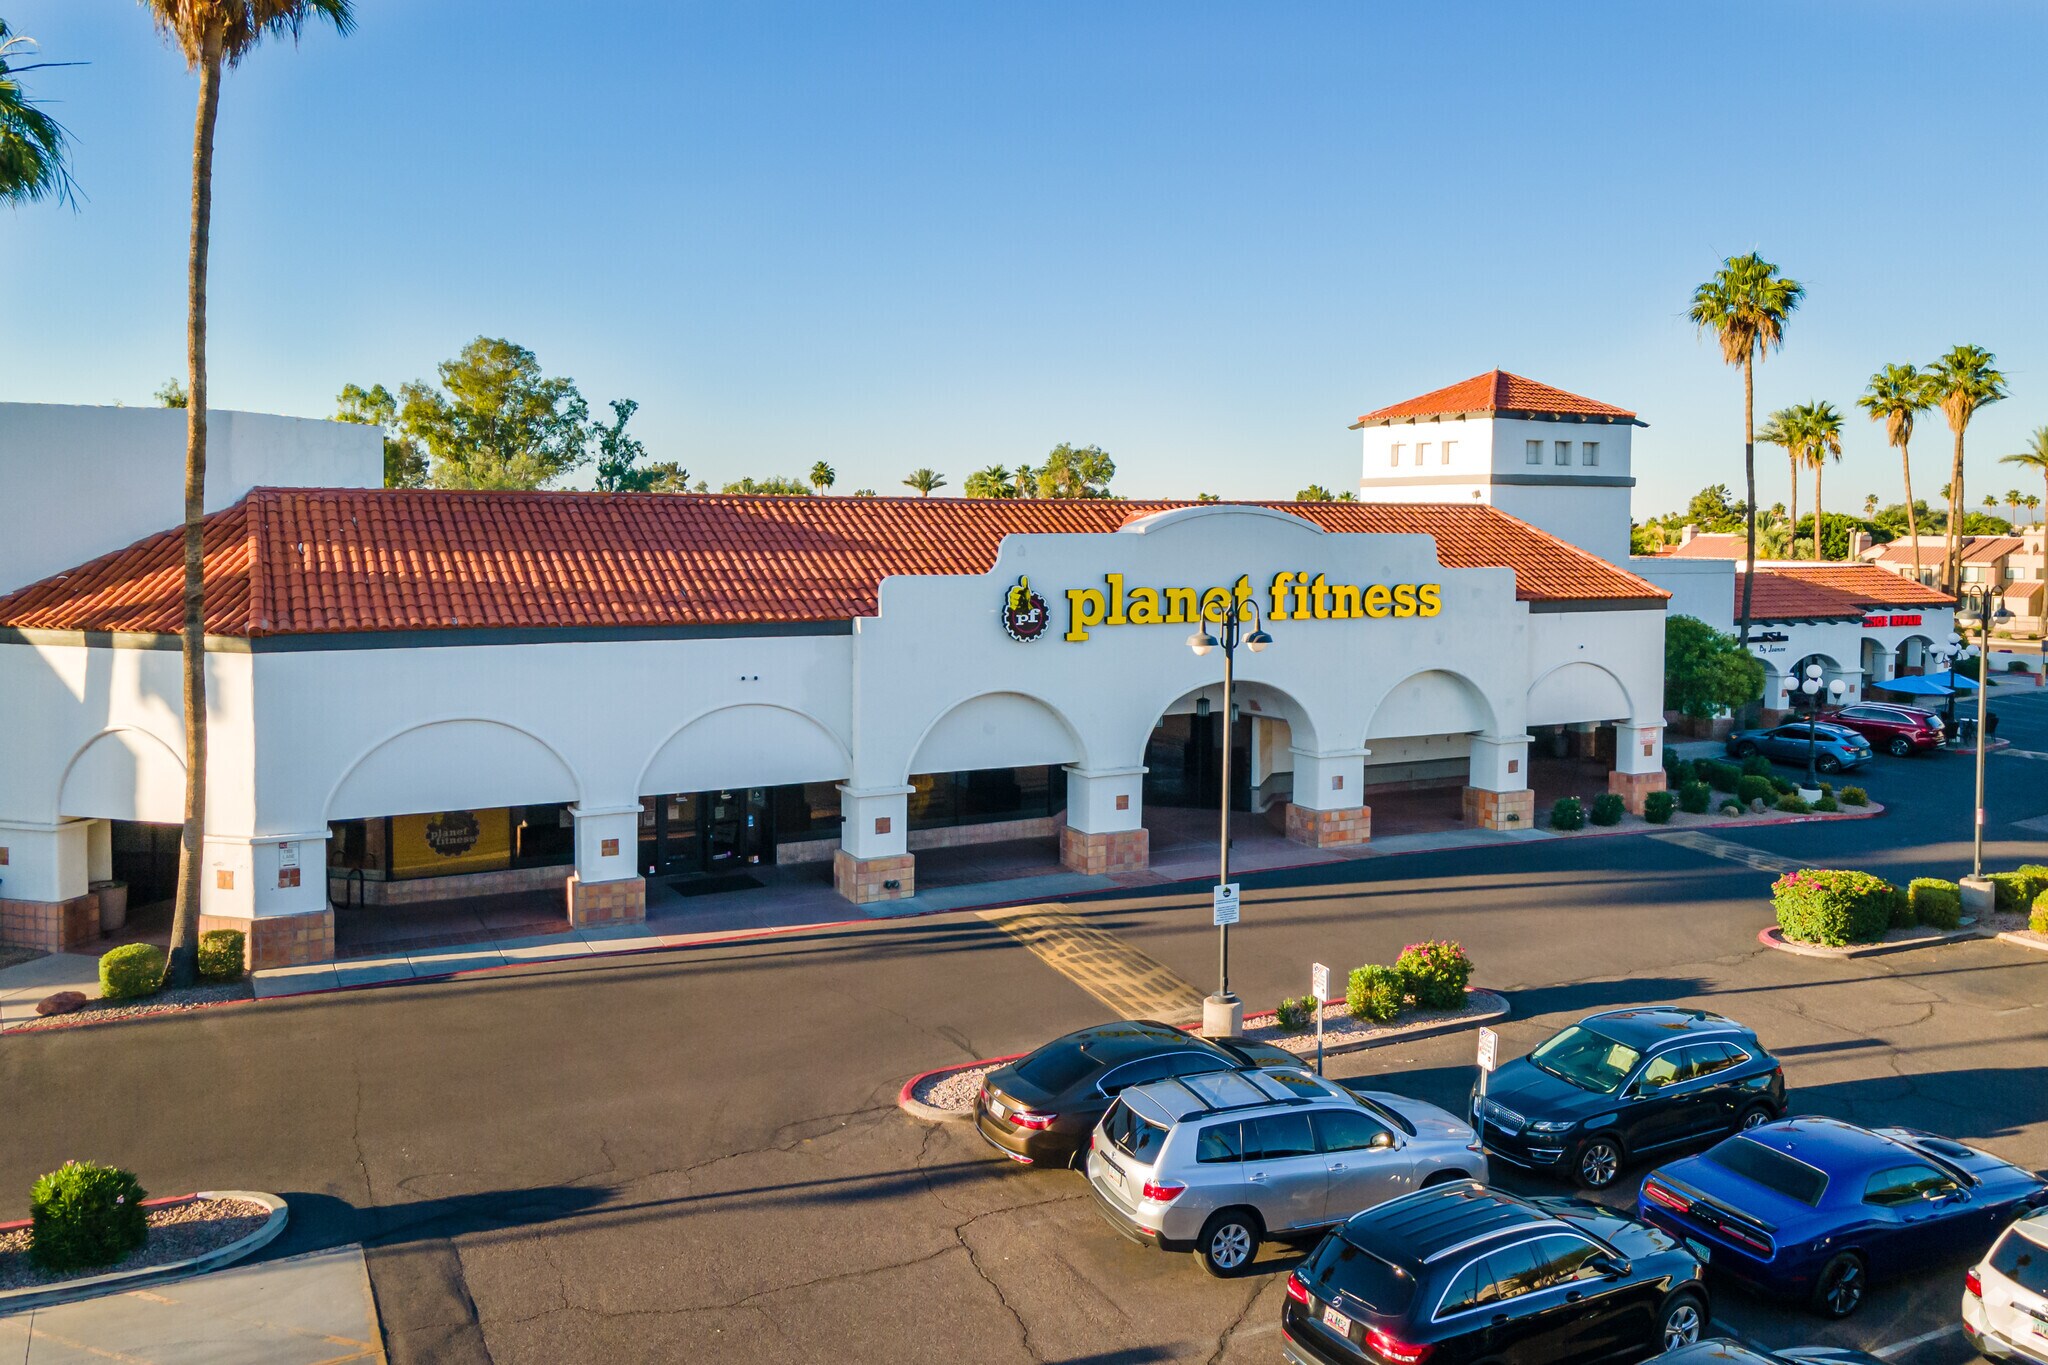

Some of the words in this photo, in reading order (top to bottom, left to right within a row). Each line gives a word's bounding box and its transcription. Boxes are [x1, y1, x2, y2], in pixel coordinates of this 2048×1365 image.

[1064, 573, 1252, 642] planet
[1268, 571, 1442, 621] fitness
[1015, 608, 1041, 626] pf
[1889, 615, 1922, 627] REPAIR
[431, 827, 467, 840] planet
[436, 836, 475, 846] fitness
